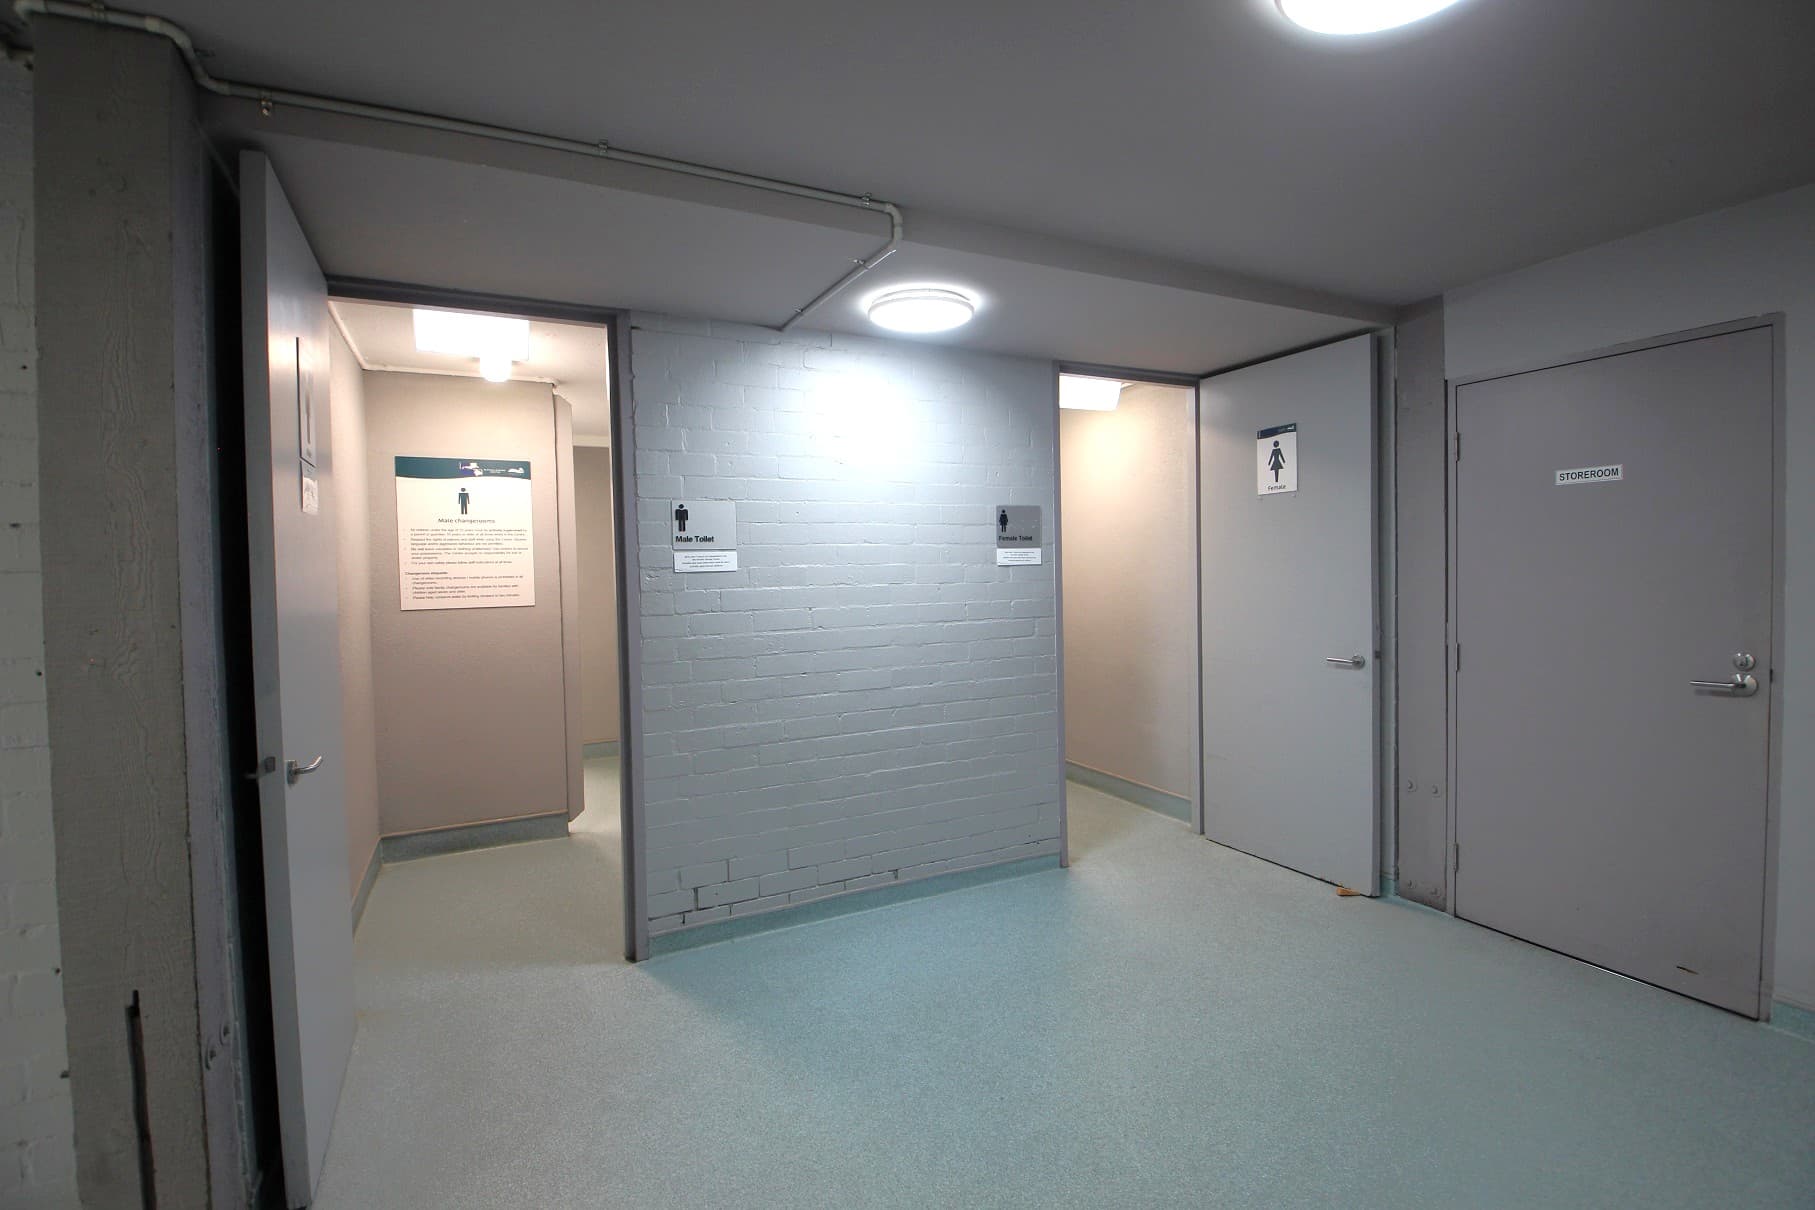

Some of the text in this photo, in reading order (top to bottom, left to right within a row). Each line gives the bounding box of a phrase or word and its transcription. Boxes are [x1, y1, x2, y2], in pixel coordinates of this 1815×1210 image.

[1559, 468, 1619, 481] STOREROOM
[675, 535, 714, 543] Male Toilet
